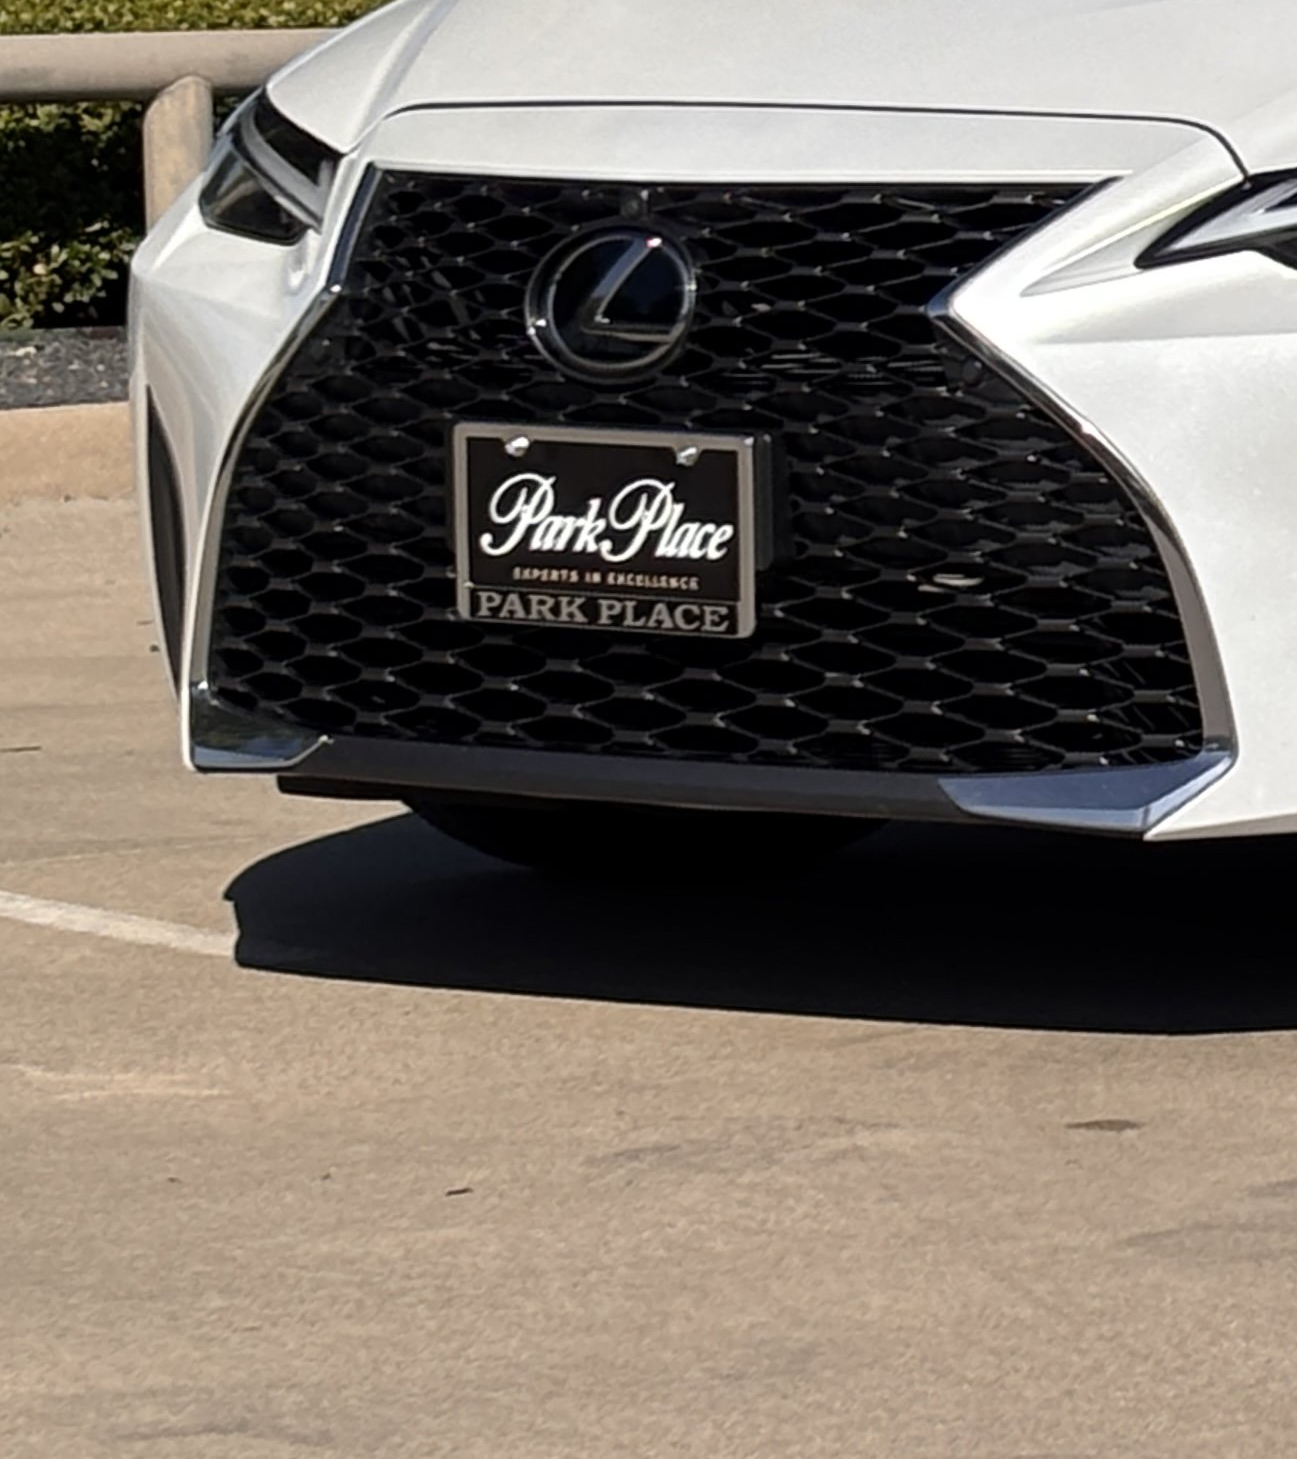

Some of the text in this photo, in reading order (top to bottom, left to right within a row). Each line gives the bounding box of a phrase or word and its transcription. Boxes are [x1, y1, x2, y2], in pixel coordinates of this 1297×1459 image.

[480, 472, 734, 563] Park Place
[513, 566, 699, 590] EXPERTS IN EXCELLENCE
[476, 591, 729, 631] PARK PLACE
